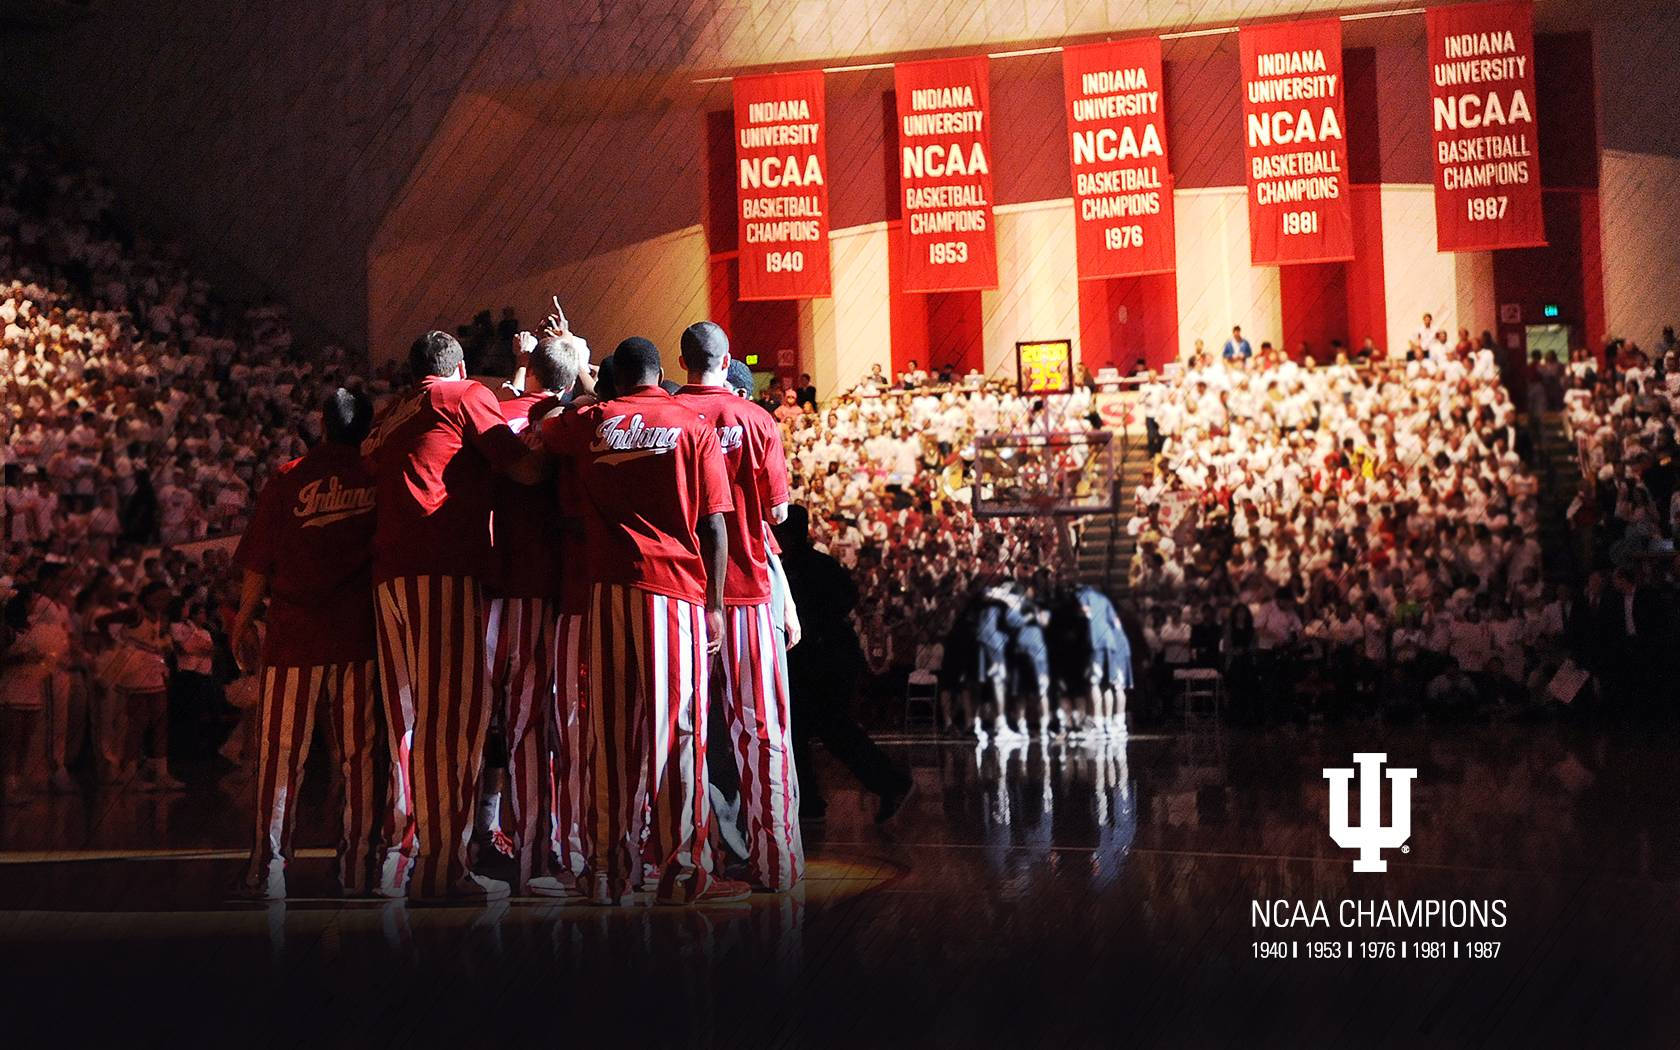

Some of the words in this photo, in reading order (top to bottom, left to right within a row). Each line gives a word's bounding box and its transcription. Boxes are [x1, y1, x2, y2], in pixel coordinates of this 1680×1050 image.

[1445, 31, 1516, 58] INDIANA
[1257, 50, 1326, 77] INDIANA
[1434, 56, 1526, 86] UNIVERSITY
[1082, 68, 1148, 95] INDIANA
[1248, 75, 1336, 103] UNIVERSITY
[749, 100, 809, 123] INDIANA
[912, 86, 974, 110] INDIANA
[1073, 92, 1158, 121] UNIVERSITY
[1433, 90, 1532, 131] NCAA
[741, 124, 819, 148] UNIVERSITY
[903, 111, 983, 136] UNIVERSITY
[1248, 107, 1342, 147] NCAA
[1073, 124, 1163, 164] NCAA
[1438, 134, 1531, 164] BASKETBALL
[741, 155, 823, 189] NCAA
[903, 143, 989, 178] NCAA
[1252, 151, 1340, 179] BASKETBALL
[1077, 167, 1161, 195] BASKETBALL
[1444, 161, 1529, 190] CHAMPIONS
[906, 185, 987, 209] BASKETBALL
[1257, 177, 1339, 205] CHAMPIONS
[743, 196, 822, 219] BASKETBALL
[1082, 193, 1160, 221] CHAMPIONS
[1468, 196, 1508, 221] 1987
[747, 221, 820, 243] CHAMPIONS
[910, 210, 986, 235] CHAMPIONS
[1283, 211, 1317, 235] 1981
[1105, 226, 1143, 250] 1976
[766, 252, 803, 272] 1940
[929, 242, 968, 264] 1953
[590, 414, 682, 452] Indiana
